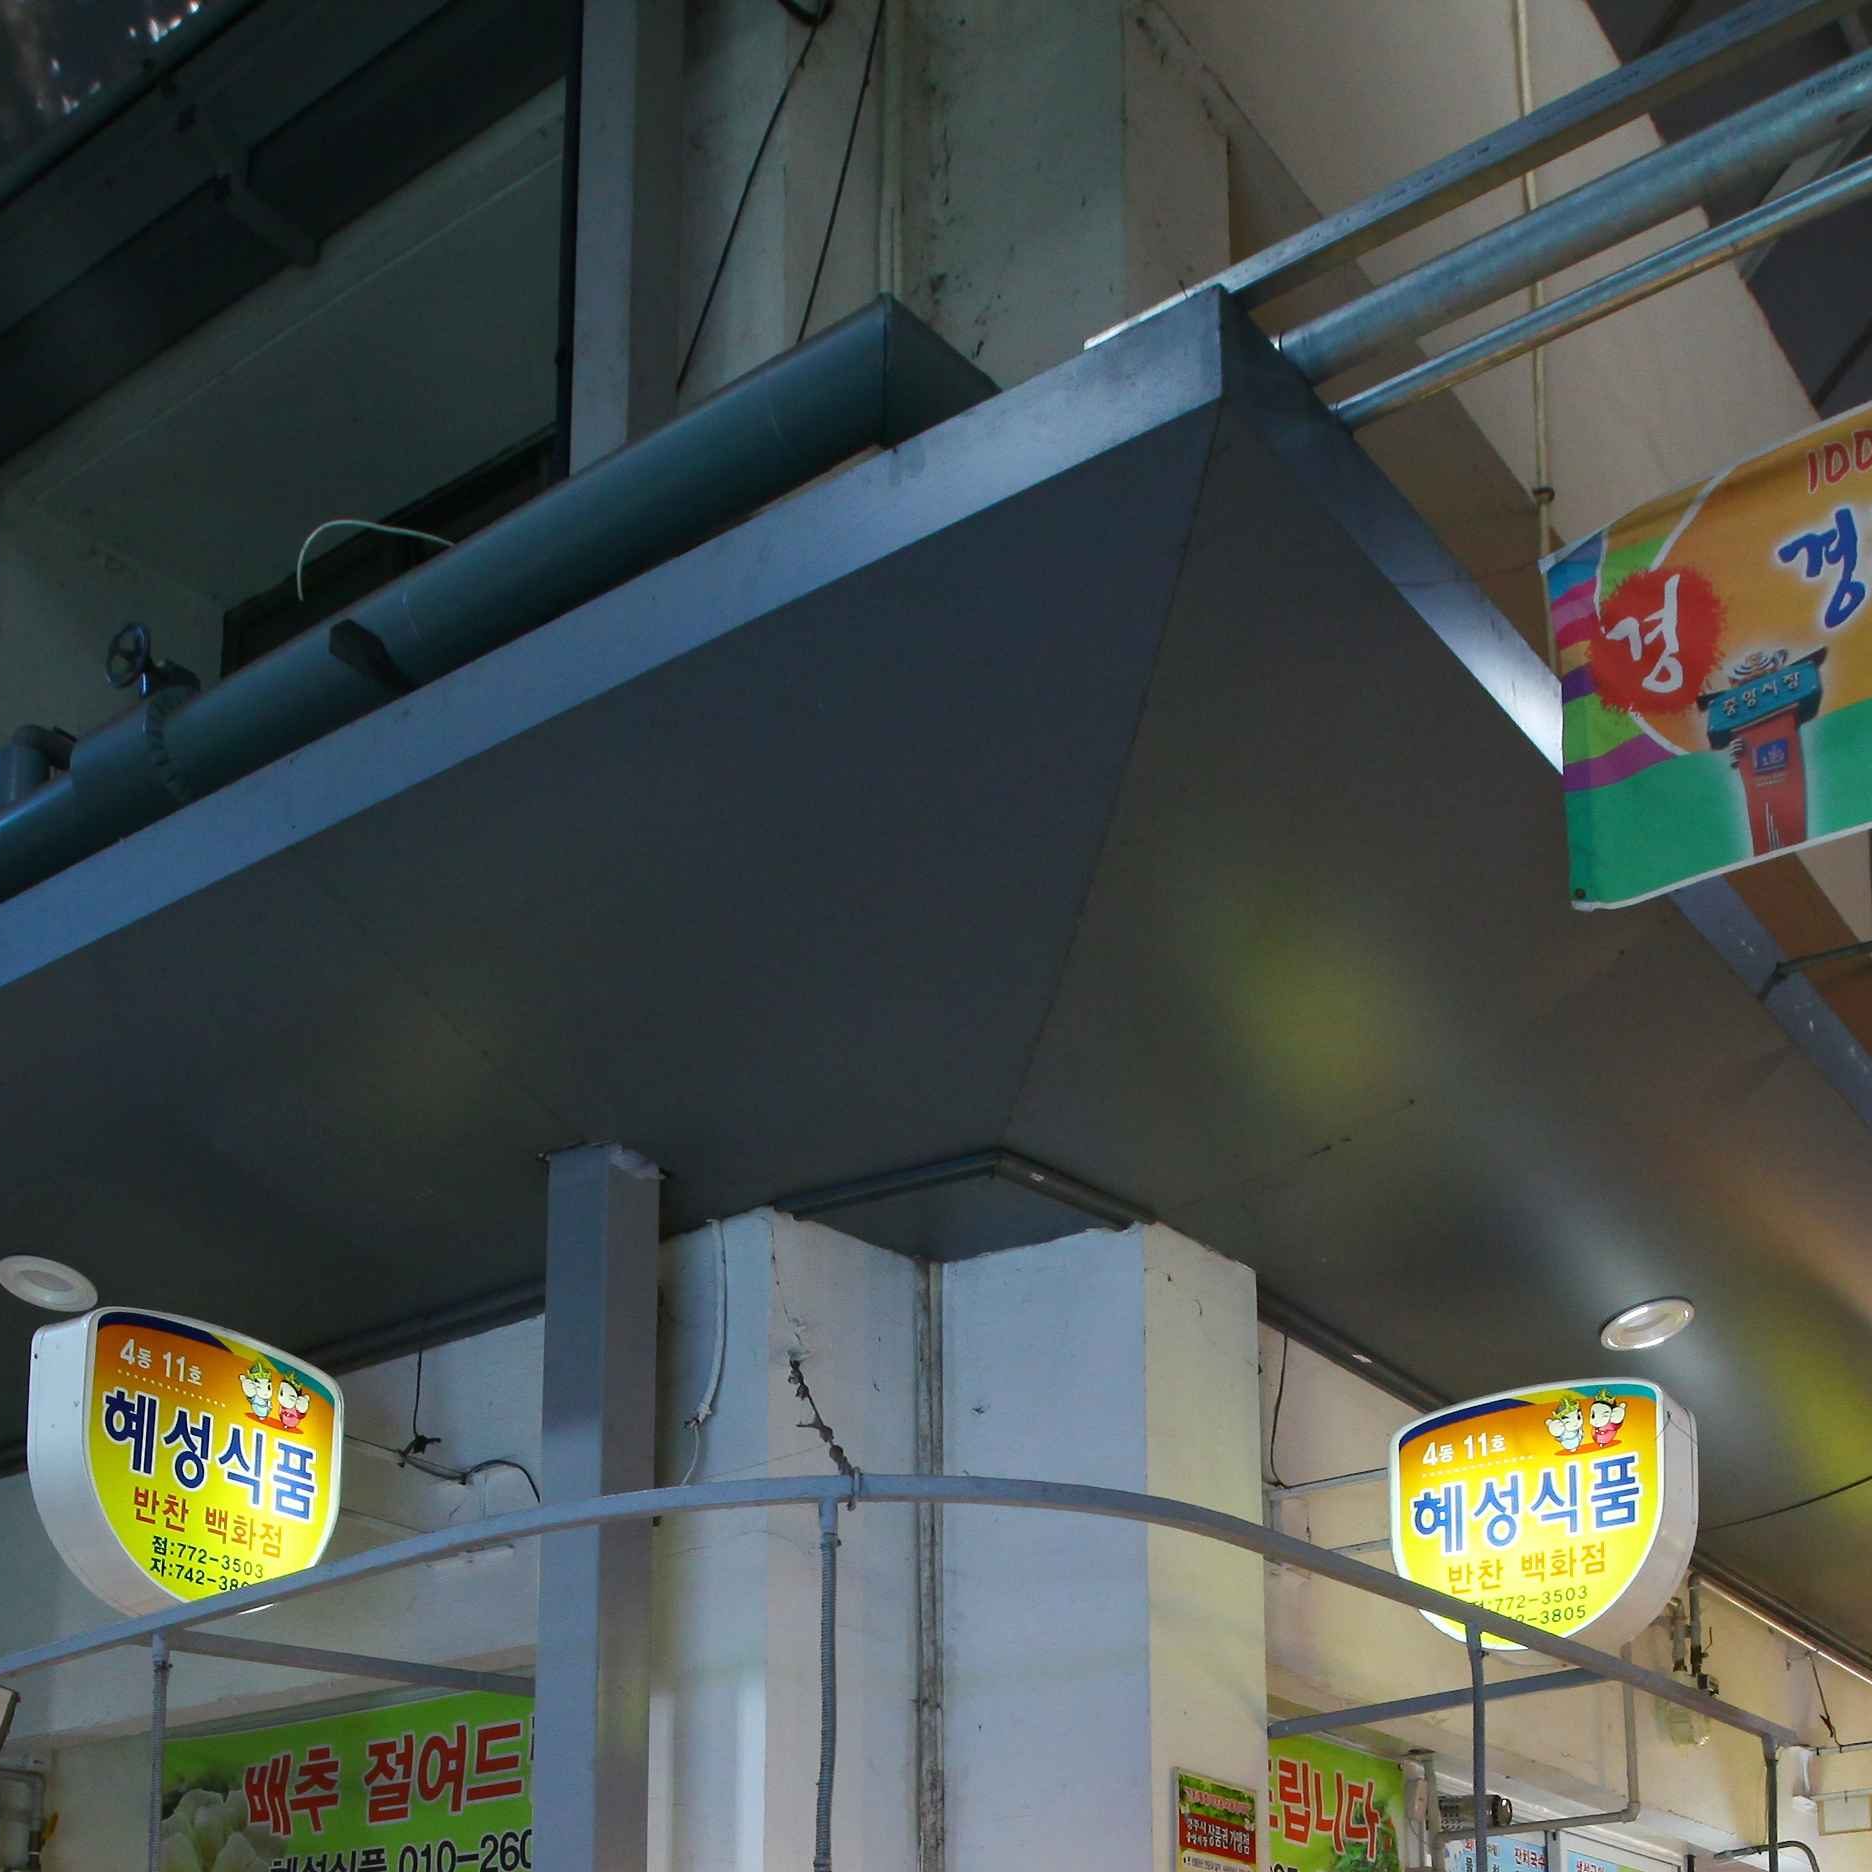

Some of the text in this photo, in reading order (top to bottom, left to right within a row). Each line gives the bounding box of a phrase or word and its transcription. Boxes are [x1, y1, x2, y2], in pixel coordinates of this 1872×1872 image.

[1605, 577, 1681, 694] 경
[119, 1338, 203, 1386] 4동 11호
[102, 1387, 319, 1522] 혜성식품
[1422, 1432, 1506, 1467] 4동 11호
[133, 1487, 282, 1558] 반찬 백화점
[1413, 1454, 1641, 1554] 혜성식품
[1447, 1542, 1608, 1595] 반찬 백화점
[243, 1720, 535, 1838] 배추 절여드
